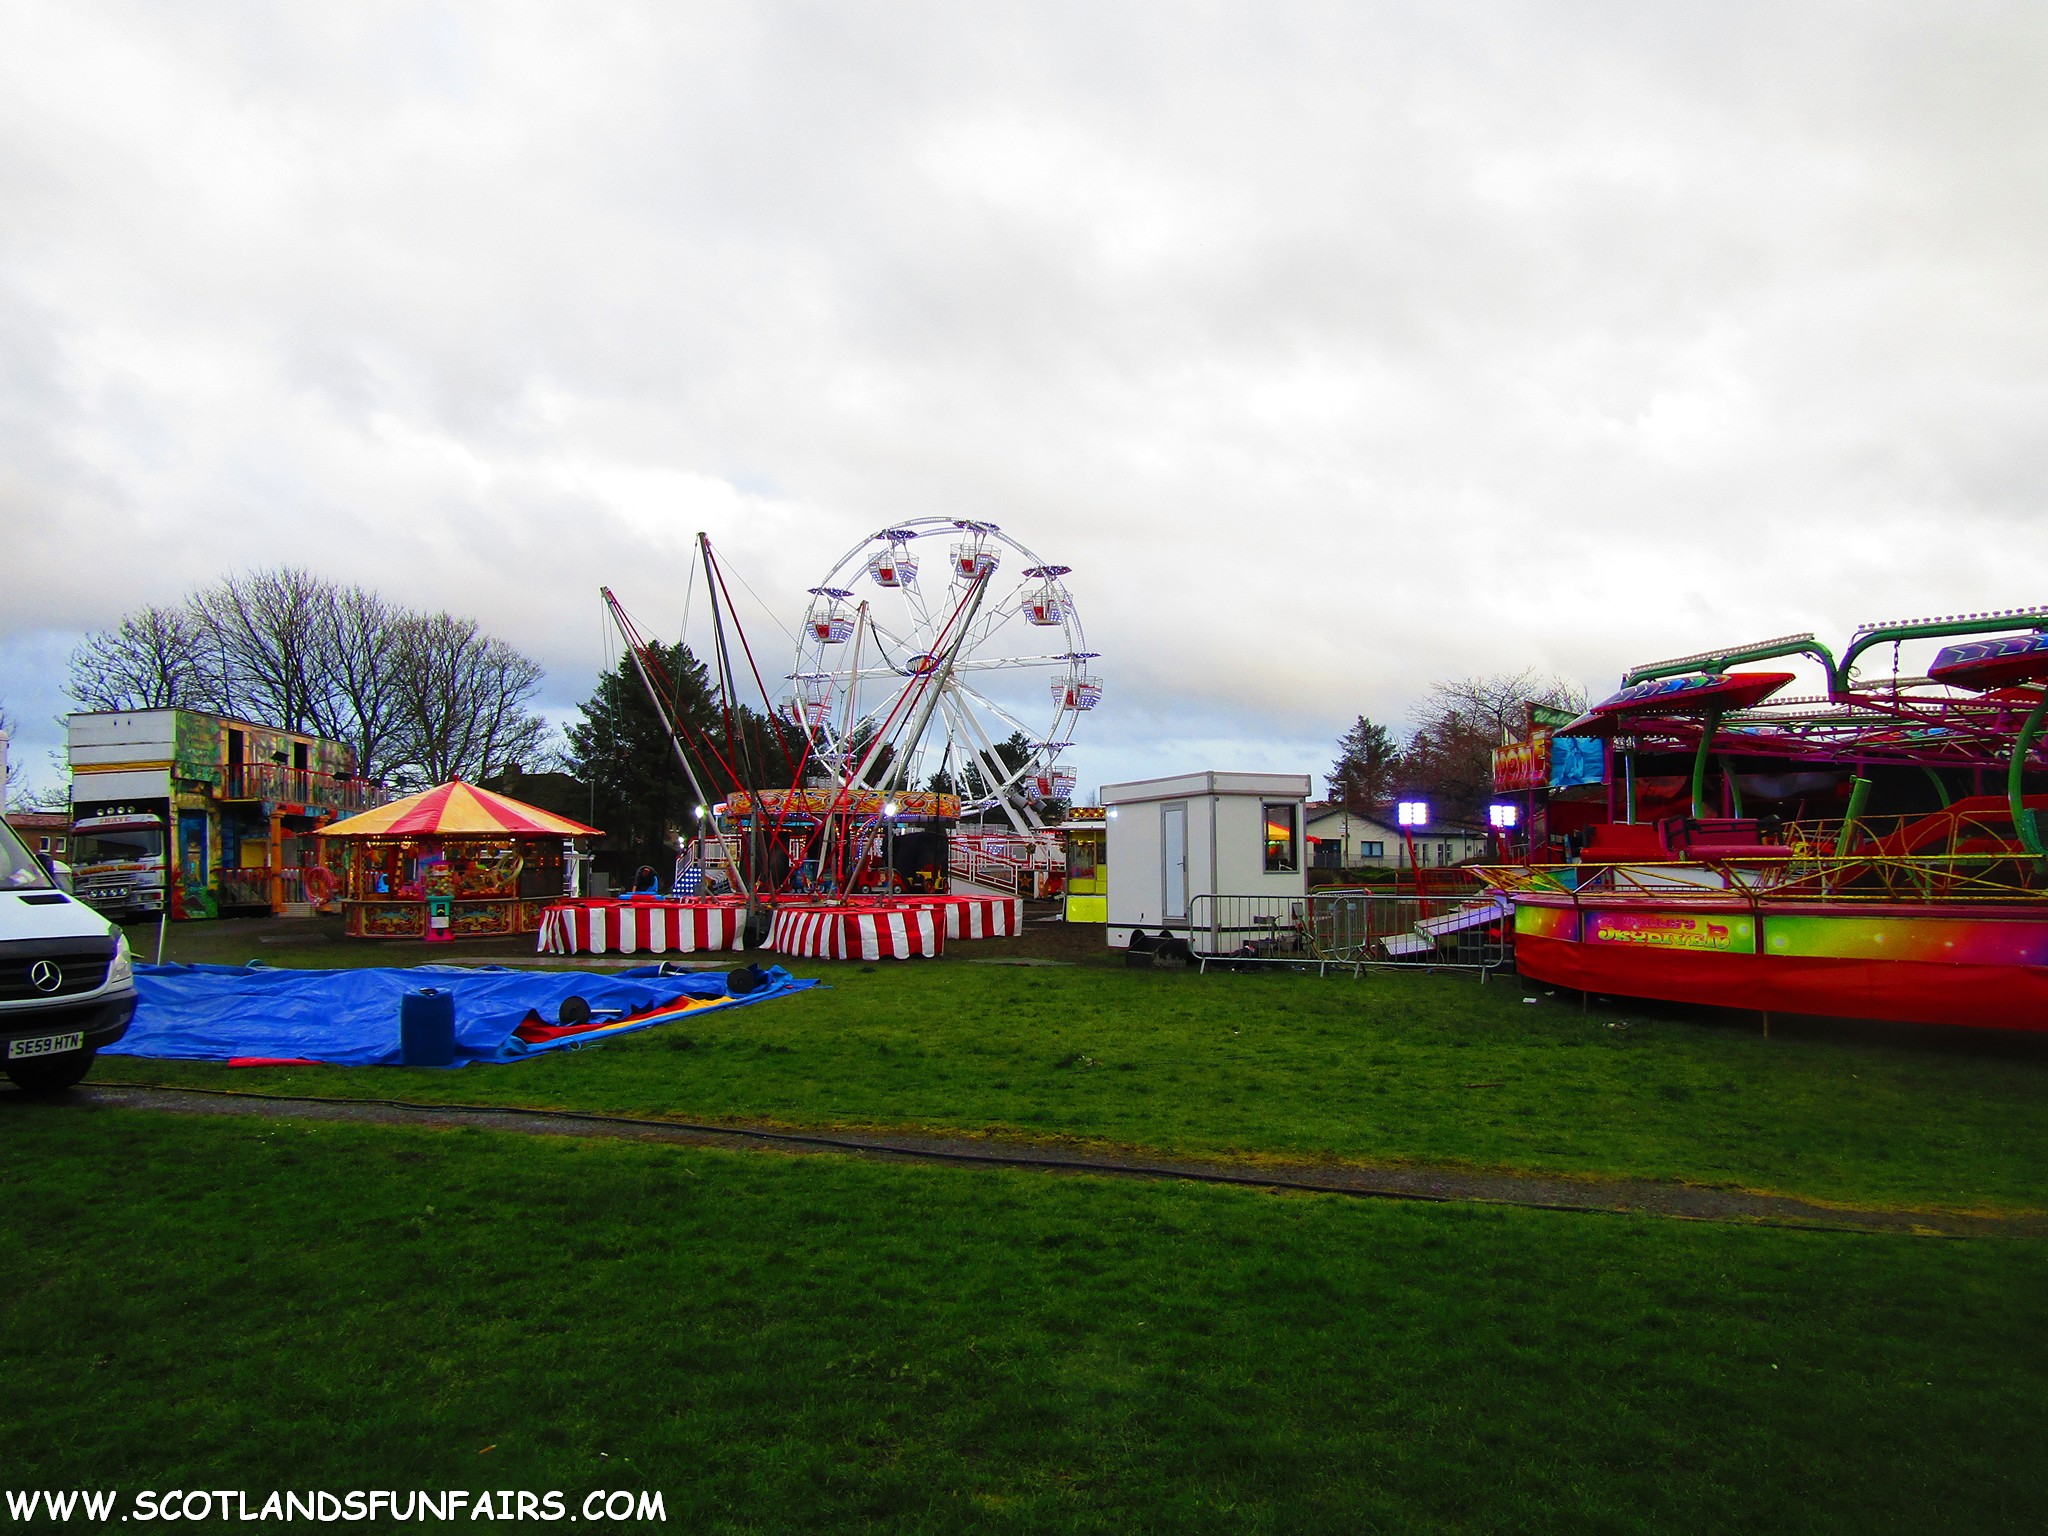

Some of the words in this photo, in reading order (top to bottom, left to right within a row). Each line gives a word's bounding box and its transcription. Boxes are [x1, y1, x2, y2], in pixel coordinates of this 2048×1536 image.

[1597, 916, 1731, 950] SKYDIVER
[15, 1039, 52, 1055] SE59
[54, 1034, 79, 1050] HTN
